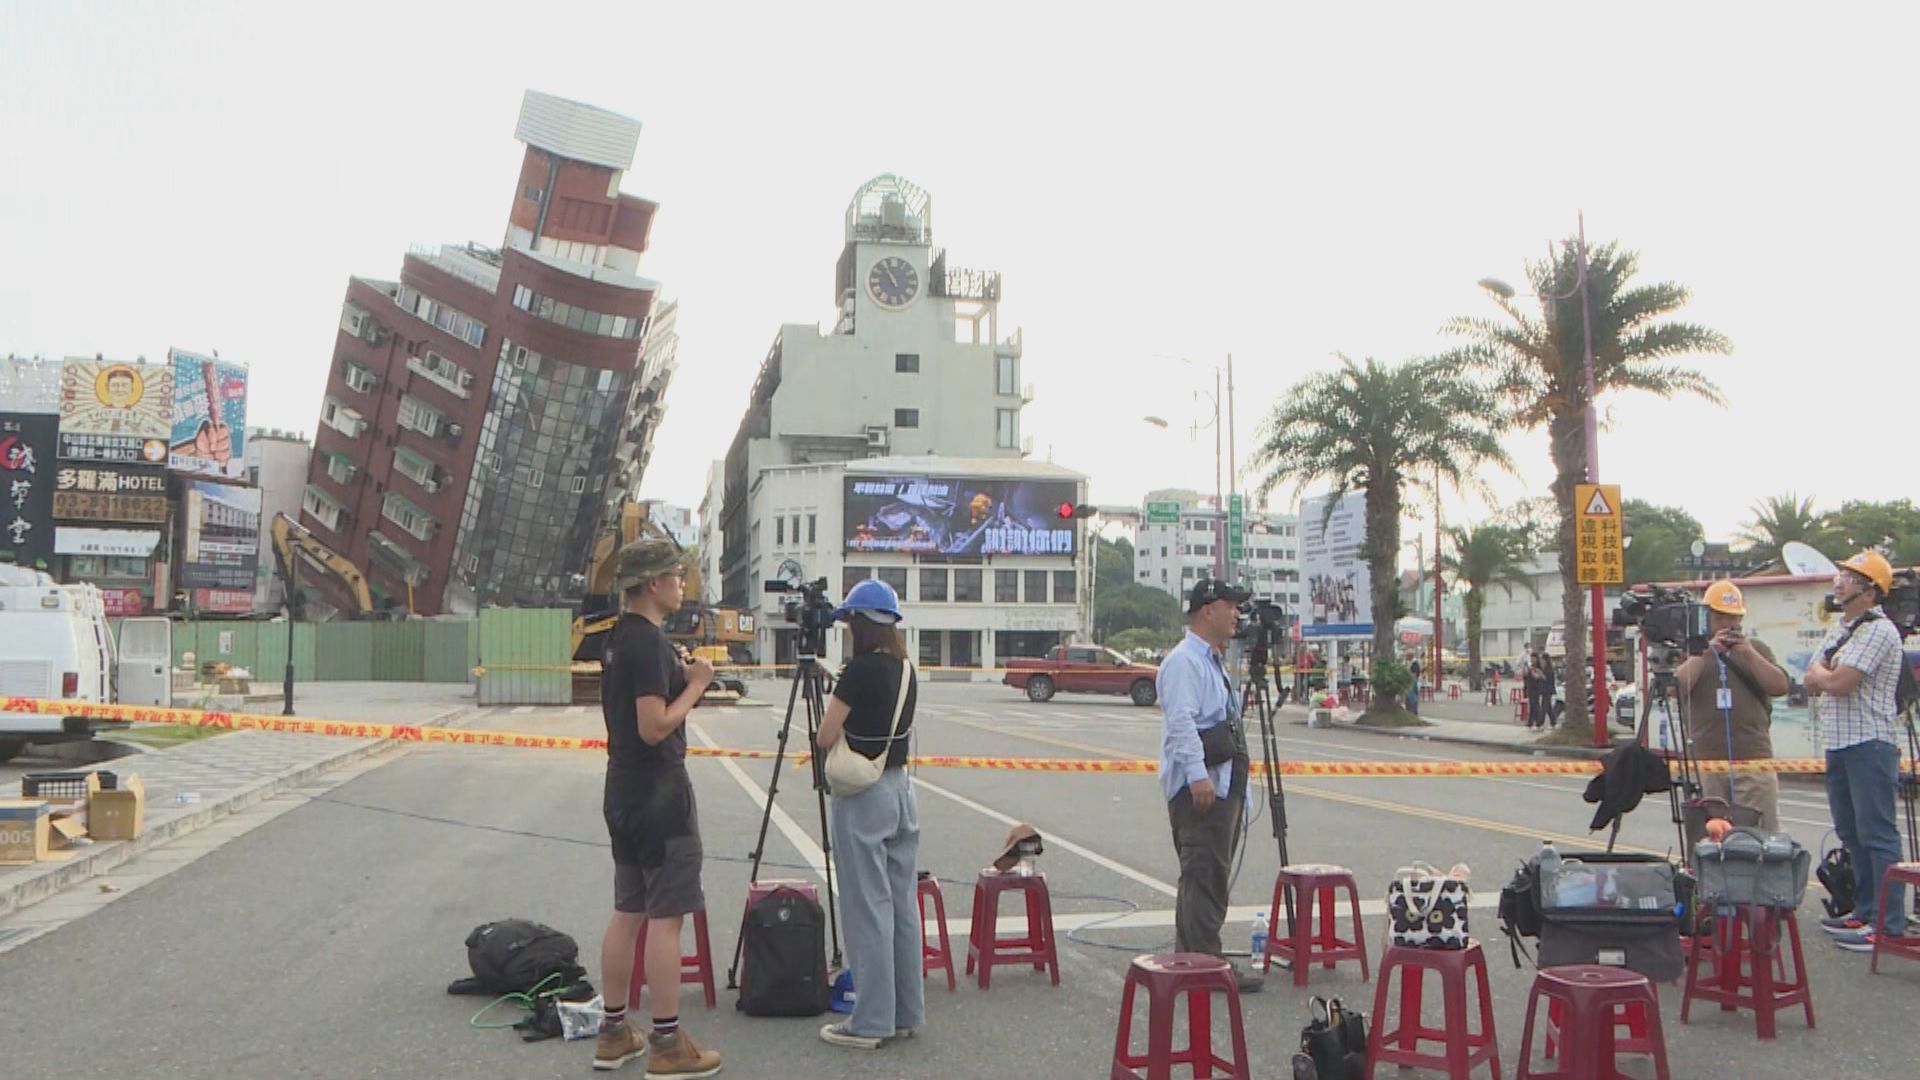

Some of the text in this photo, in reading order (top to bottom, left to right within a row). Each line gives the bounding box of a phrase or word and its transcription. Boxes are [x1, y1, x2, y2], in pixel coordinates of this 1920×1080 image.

[119, 475, 165, 491] HOTEL
[1601, 518, 1619, 581] 科技執法
[739, 614, 754, 631] CAT
